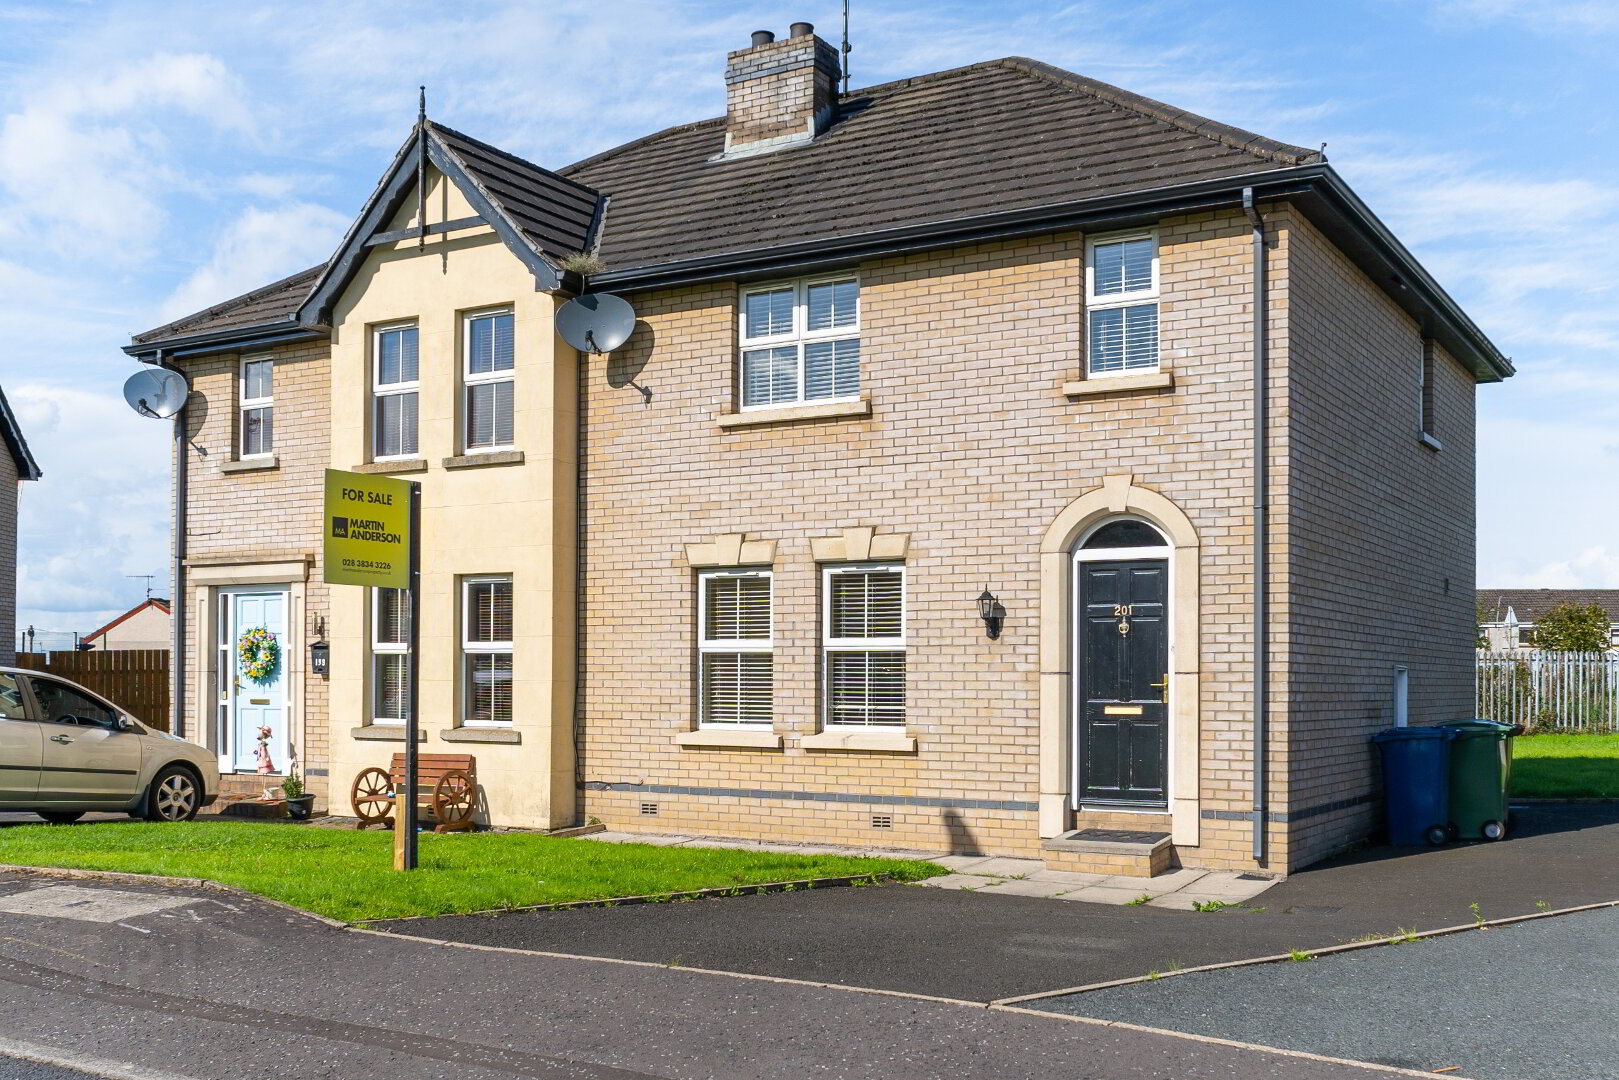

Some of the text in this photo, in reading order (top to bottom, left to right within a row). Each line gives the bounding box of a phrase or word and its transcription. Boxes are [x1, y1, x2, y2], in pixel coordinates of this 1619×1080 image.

[342, 488, 392, 505] FOR SALE
[350, 518, 384, 531] MARTIN
[351, 530, 401, 544] ANDERSON
[357, 560, 373, 568] 3834
[375, 561, 391, 569] 3226
[1114, 605, 1132, 616] 201
